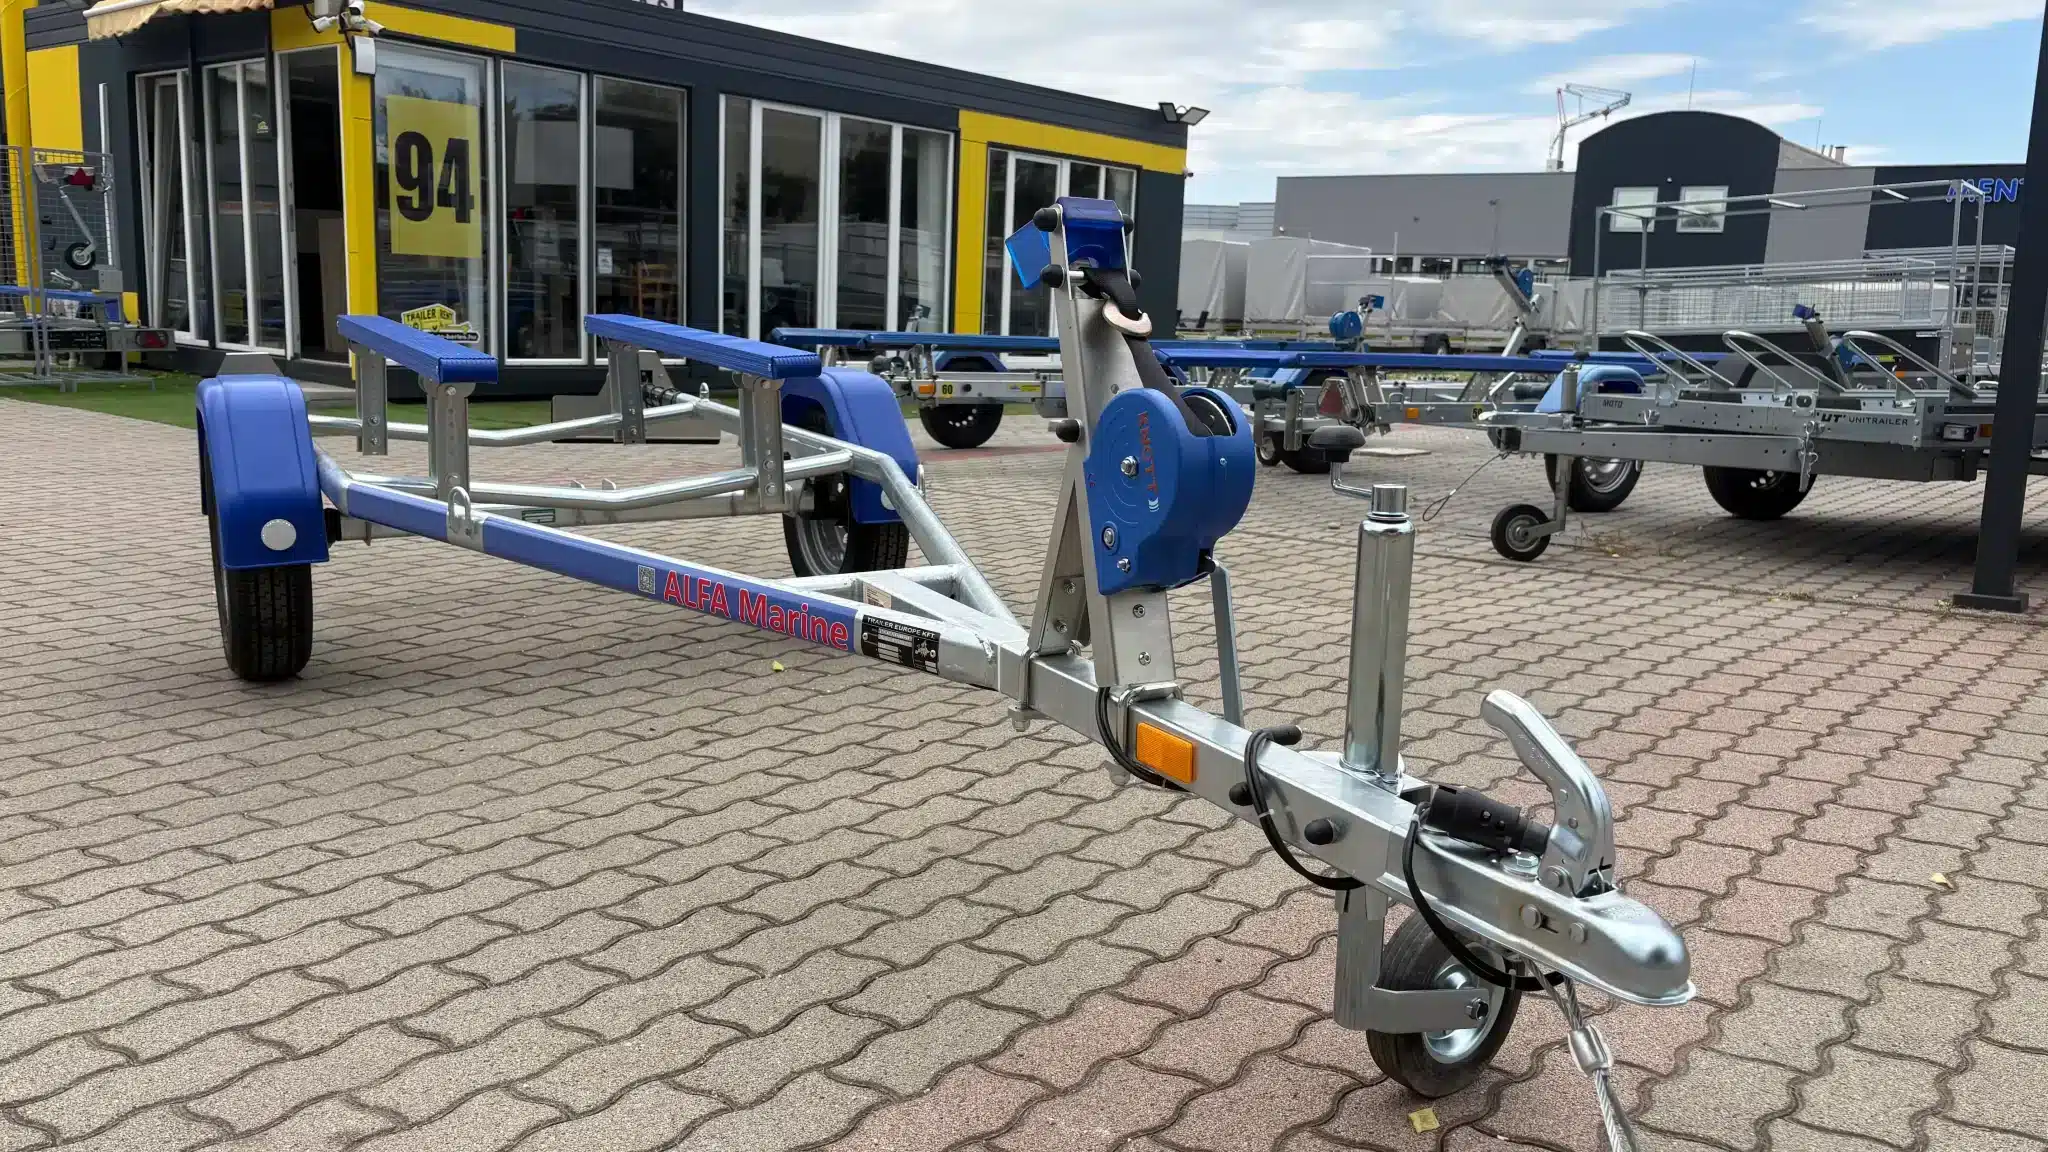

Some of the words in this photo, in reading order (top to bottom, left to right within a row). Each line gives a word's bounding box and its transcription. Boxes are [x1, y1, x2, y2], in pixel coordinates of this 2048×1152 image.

[395, 131, 475, 224] 94
[406, 309, 436, 322] TRAILER
[942, 384, 953, 395] 60
[1603, 399, 1624, 409] MOTO
[1848, 416, 1908, 426] UNITRAILER
[663, 569, 731, 619] ALFA
[738, 588, 850, 651] Marine
[867, 616, 894, 630] TRAILER
[894, 623, 921, 636] EUROPE
[921, 630, 936, 640] KFT
